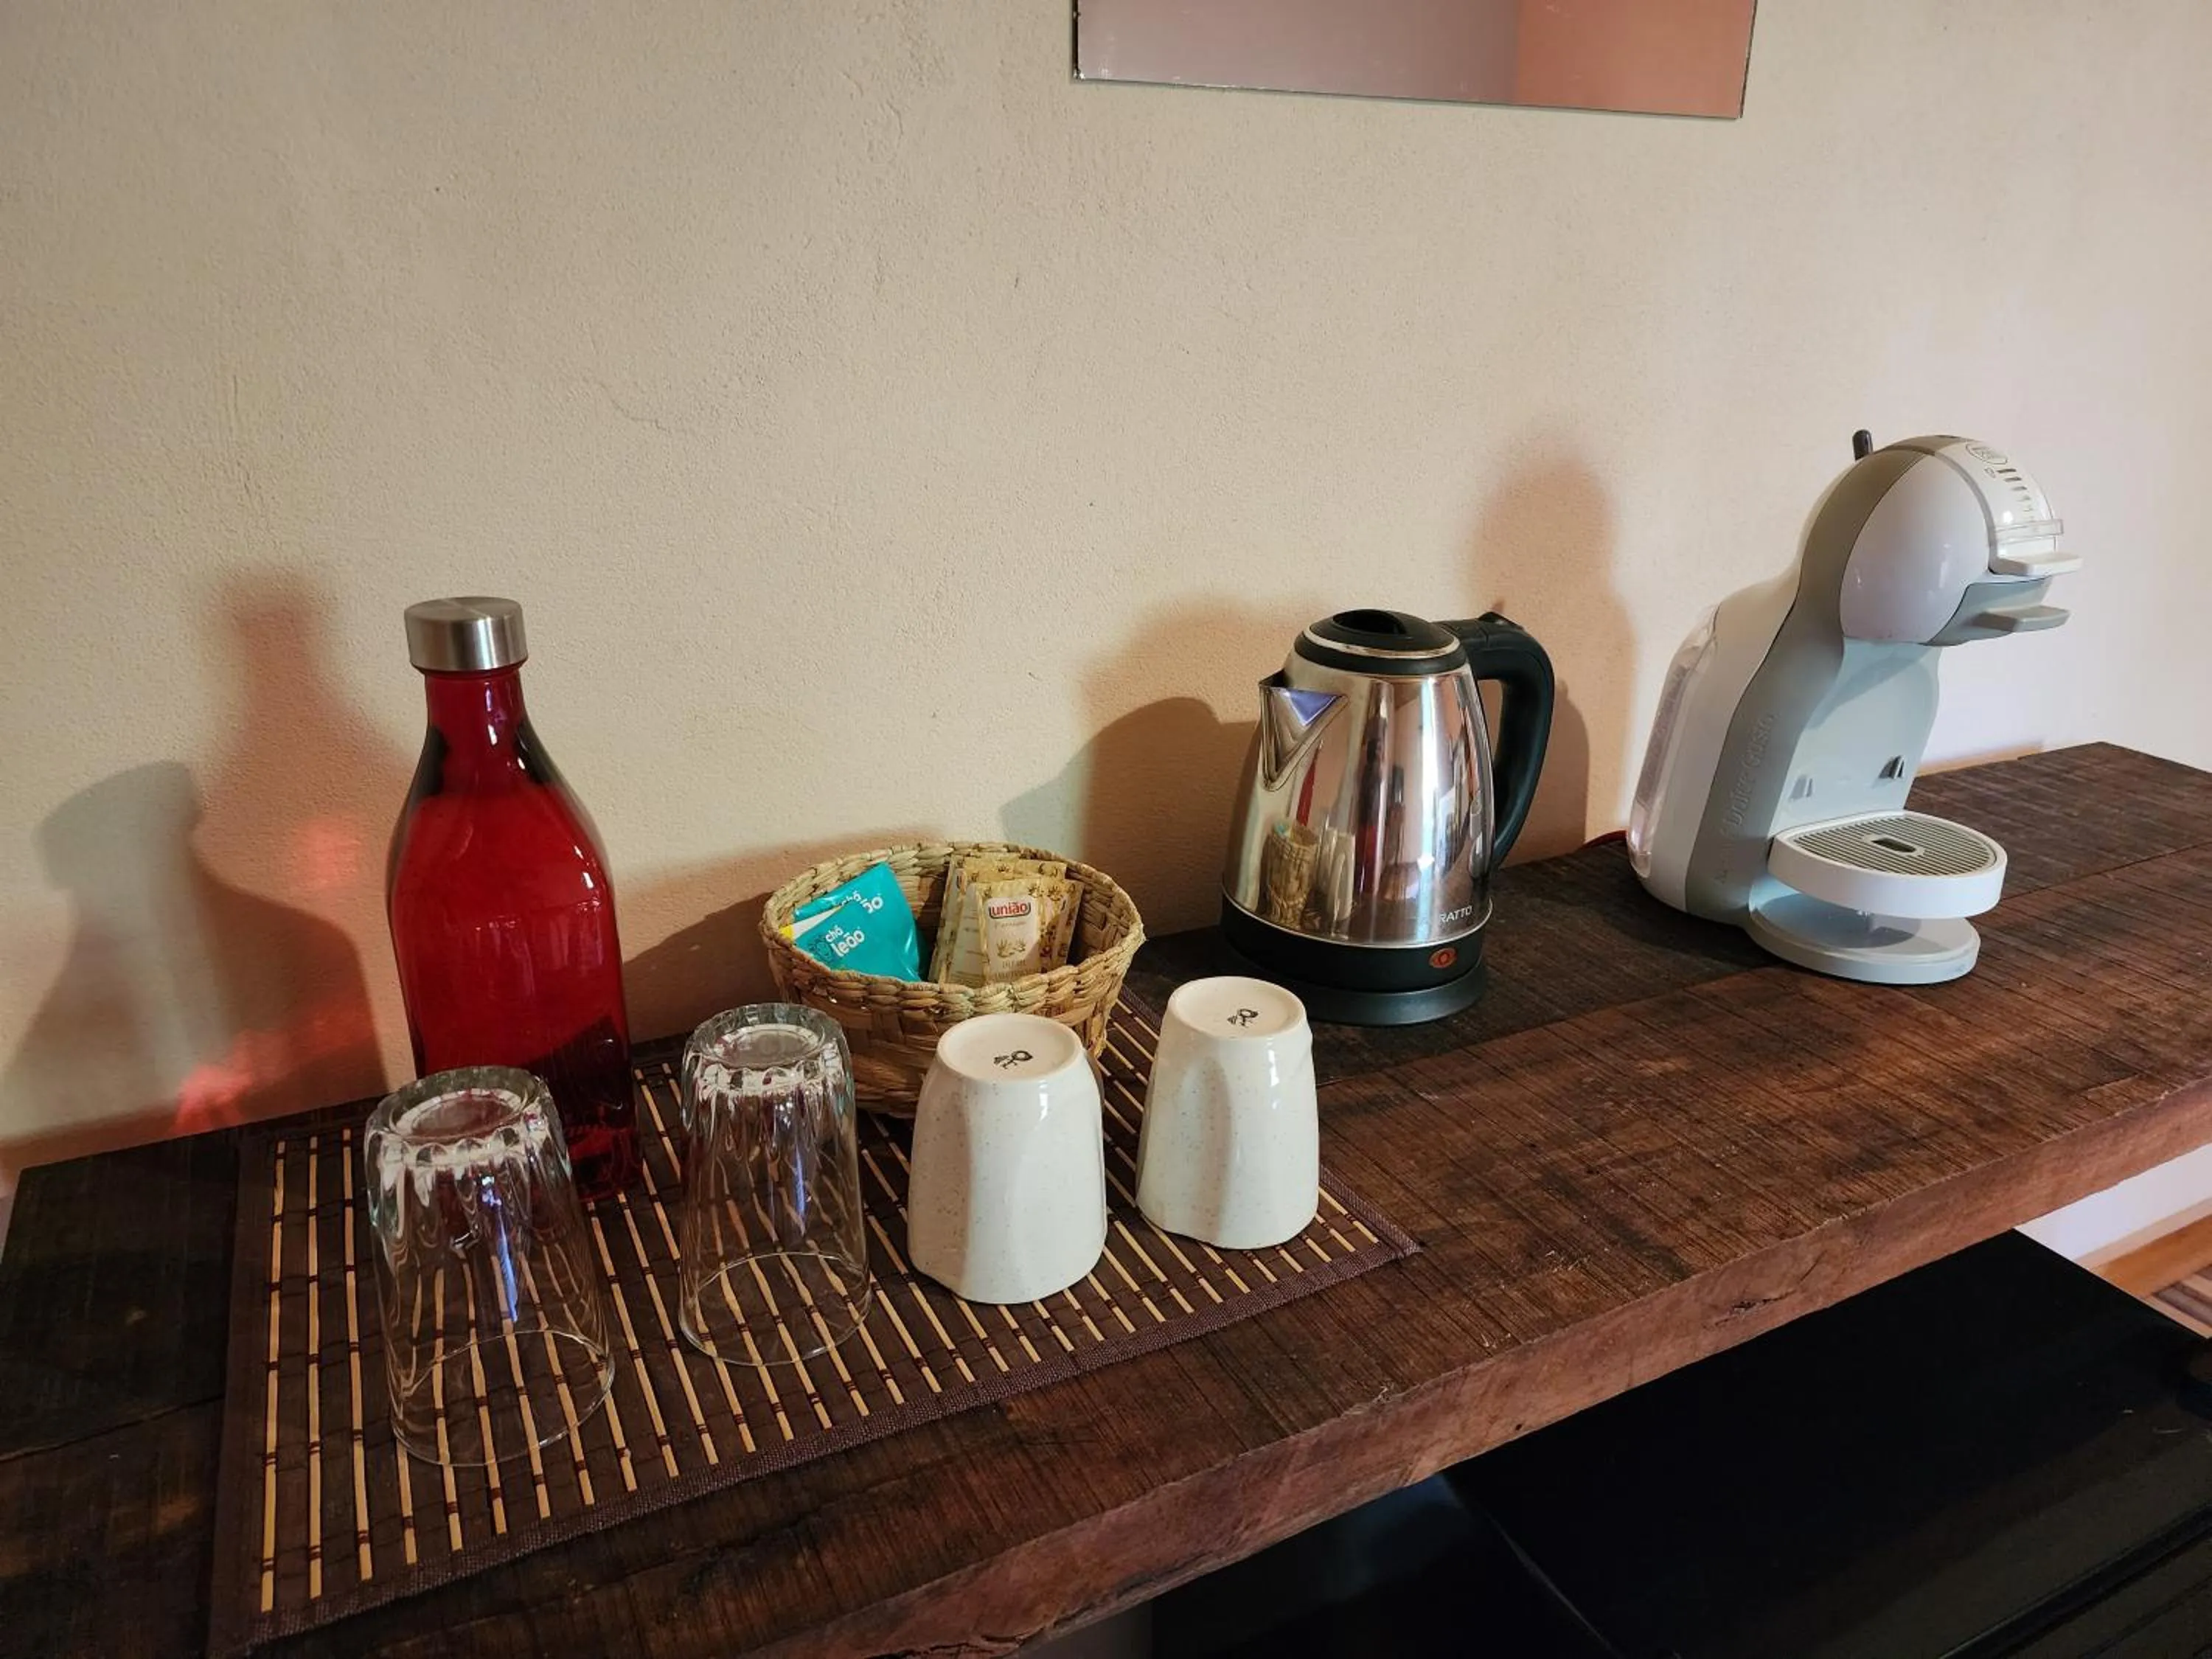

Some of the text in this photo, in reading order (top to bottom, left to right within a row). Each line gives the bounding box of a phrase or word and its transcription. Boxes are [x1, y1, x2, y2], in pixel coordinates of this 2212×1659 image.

[991, 901, 1029, 917] união
[825, 925, 844, 942] chá
[831, 930, 866, 958] leão
